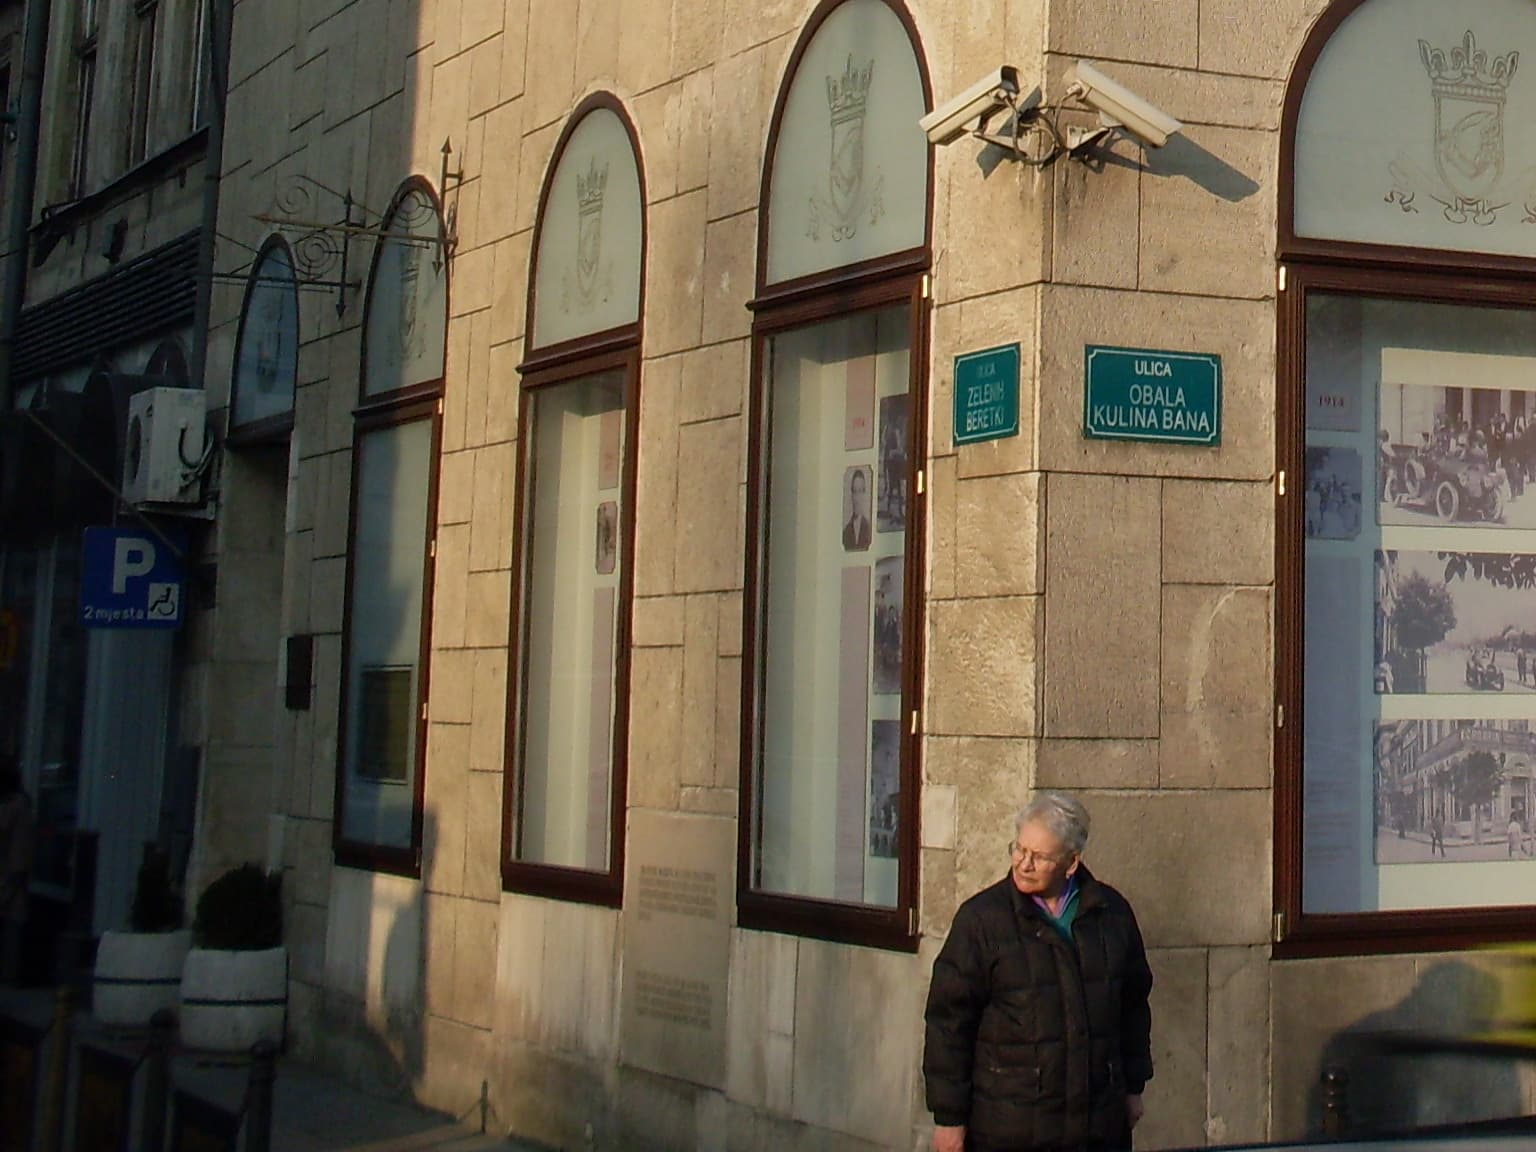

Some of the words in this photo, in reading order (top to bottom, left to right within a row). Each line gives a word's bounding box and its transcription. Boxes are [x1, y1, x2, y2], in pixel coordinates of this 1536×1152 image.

[1134, 359, 1173, 378] ULICA
[1129, 383, 1187, 409] OBALA
[966, 405, 1005, 433] BERETKI
[1093, 406, 1159, 430] KULINA
[1161, 407, 1211, 433] BANA
[112, 537, 156, 594] P
[83, 605, 93, 620] 2
